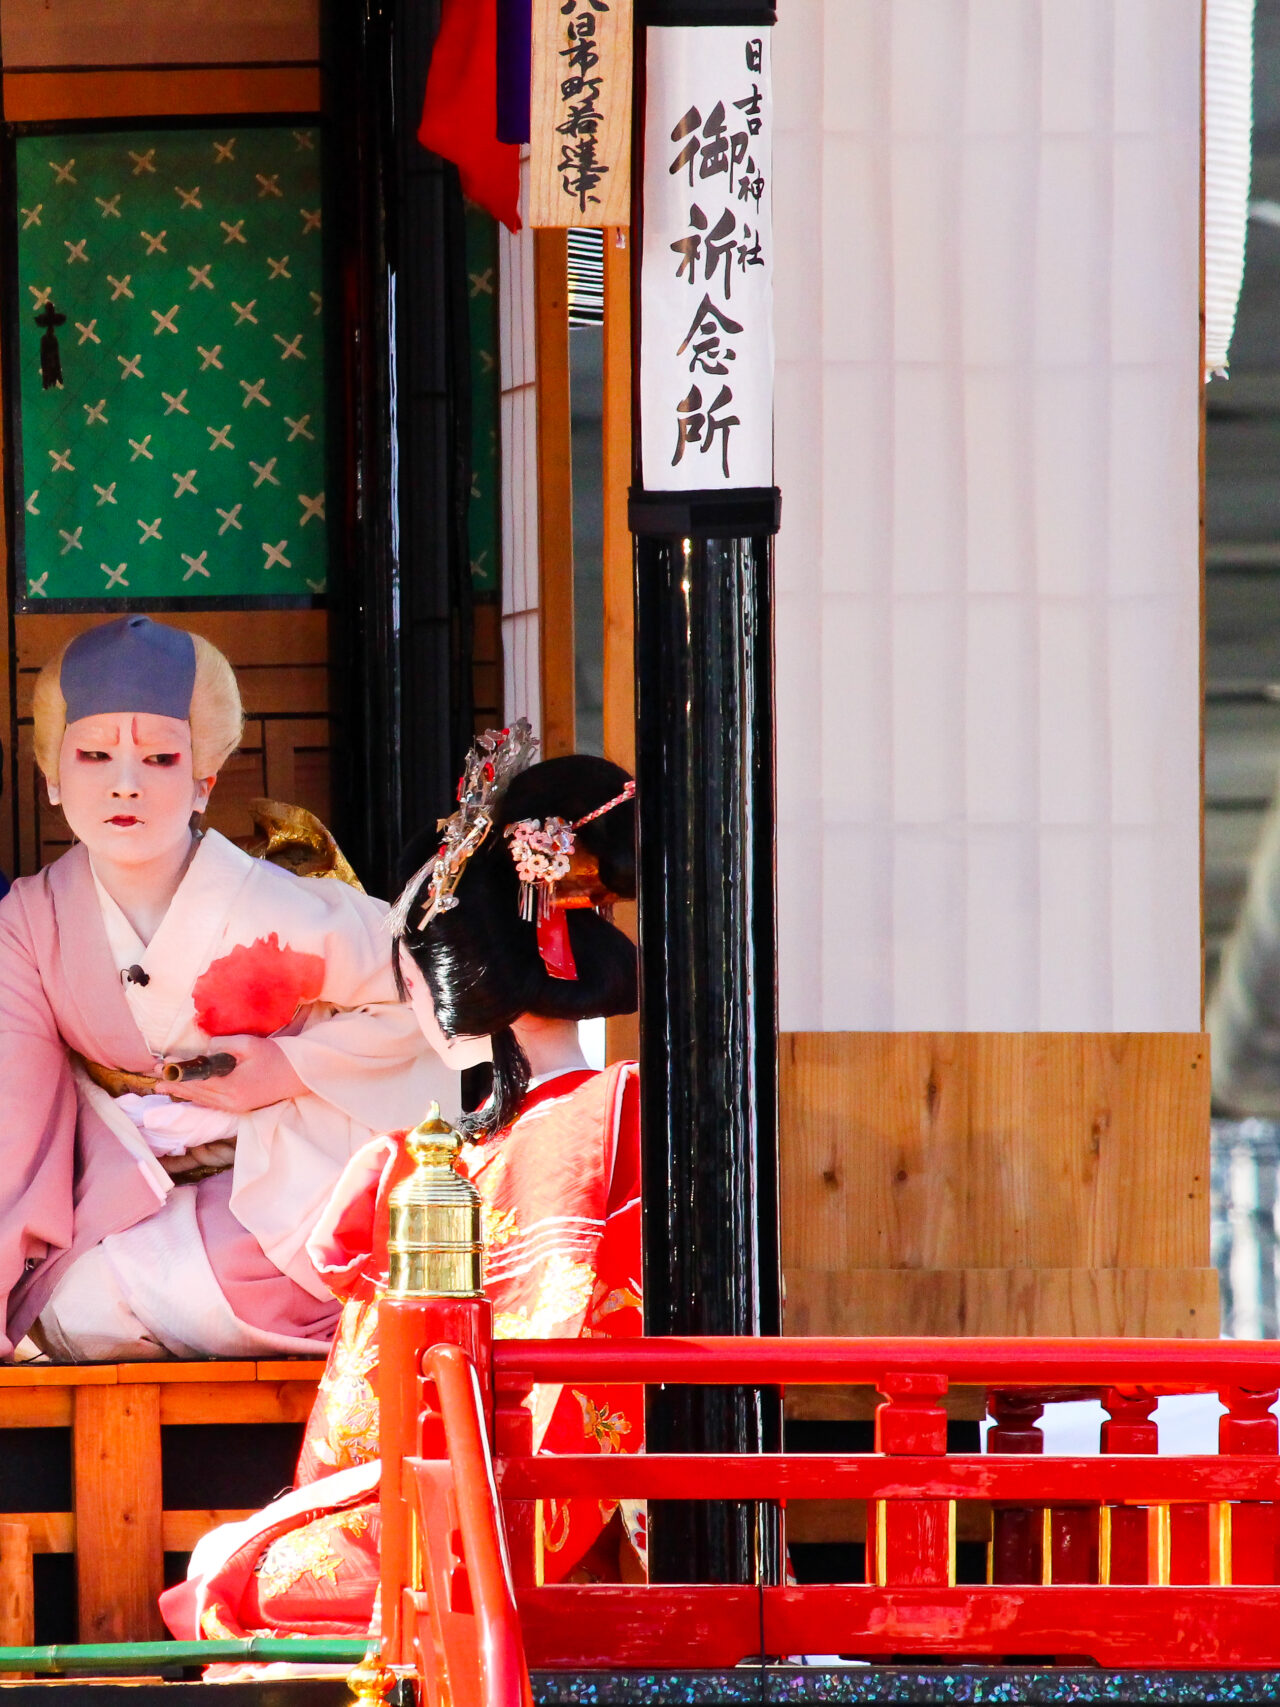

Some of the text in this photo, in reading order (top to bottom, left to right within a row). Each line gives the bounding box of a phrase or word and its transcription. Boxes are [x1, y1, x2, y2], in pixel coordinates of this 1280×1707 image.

[669, 100, 748, 479] 御祈念所
[733, 39, 765, 273] 日吉神社
